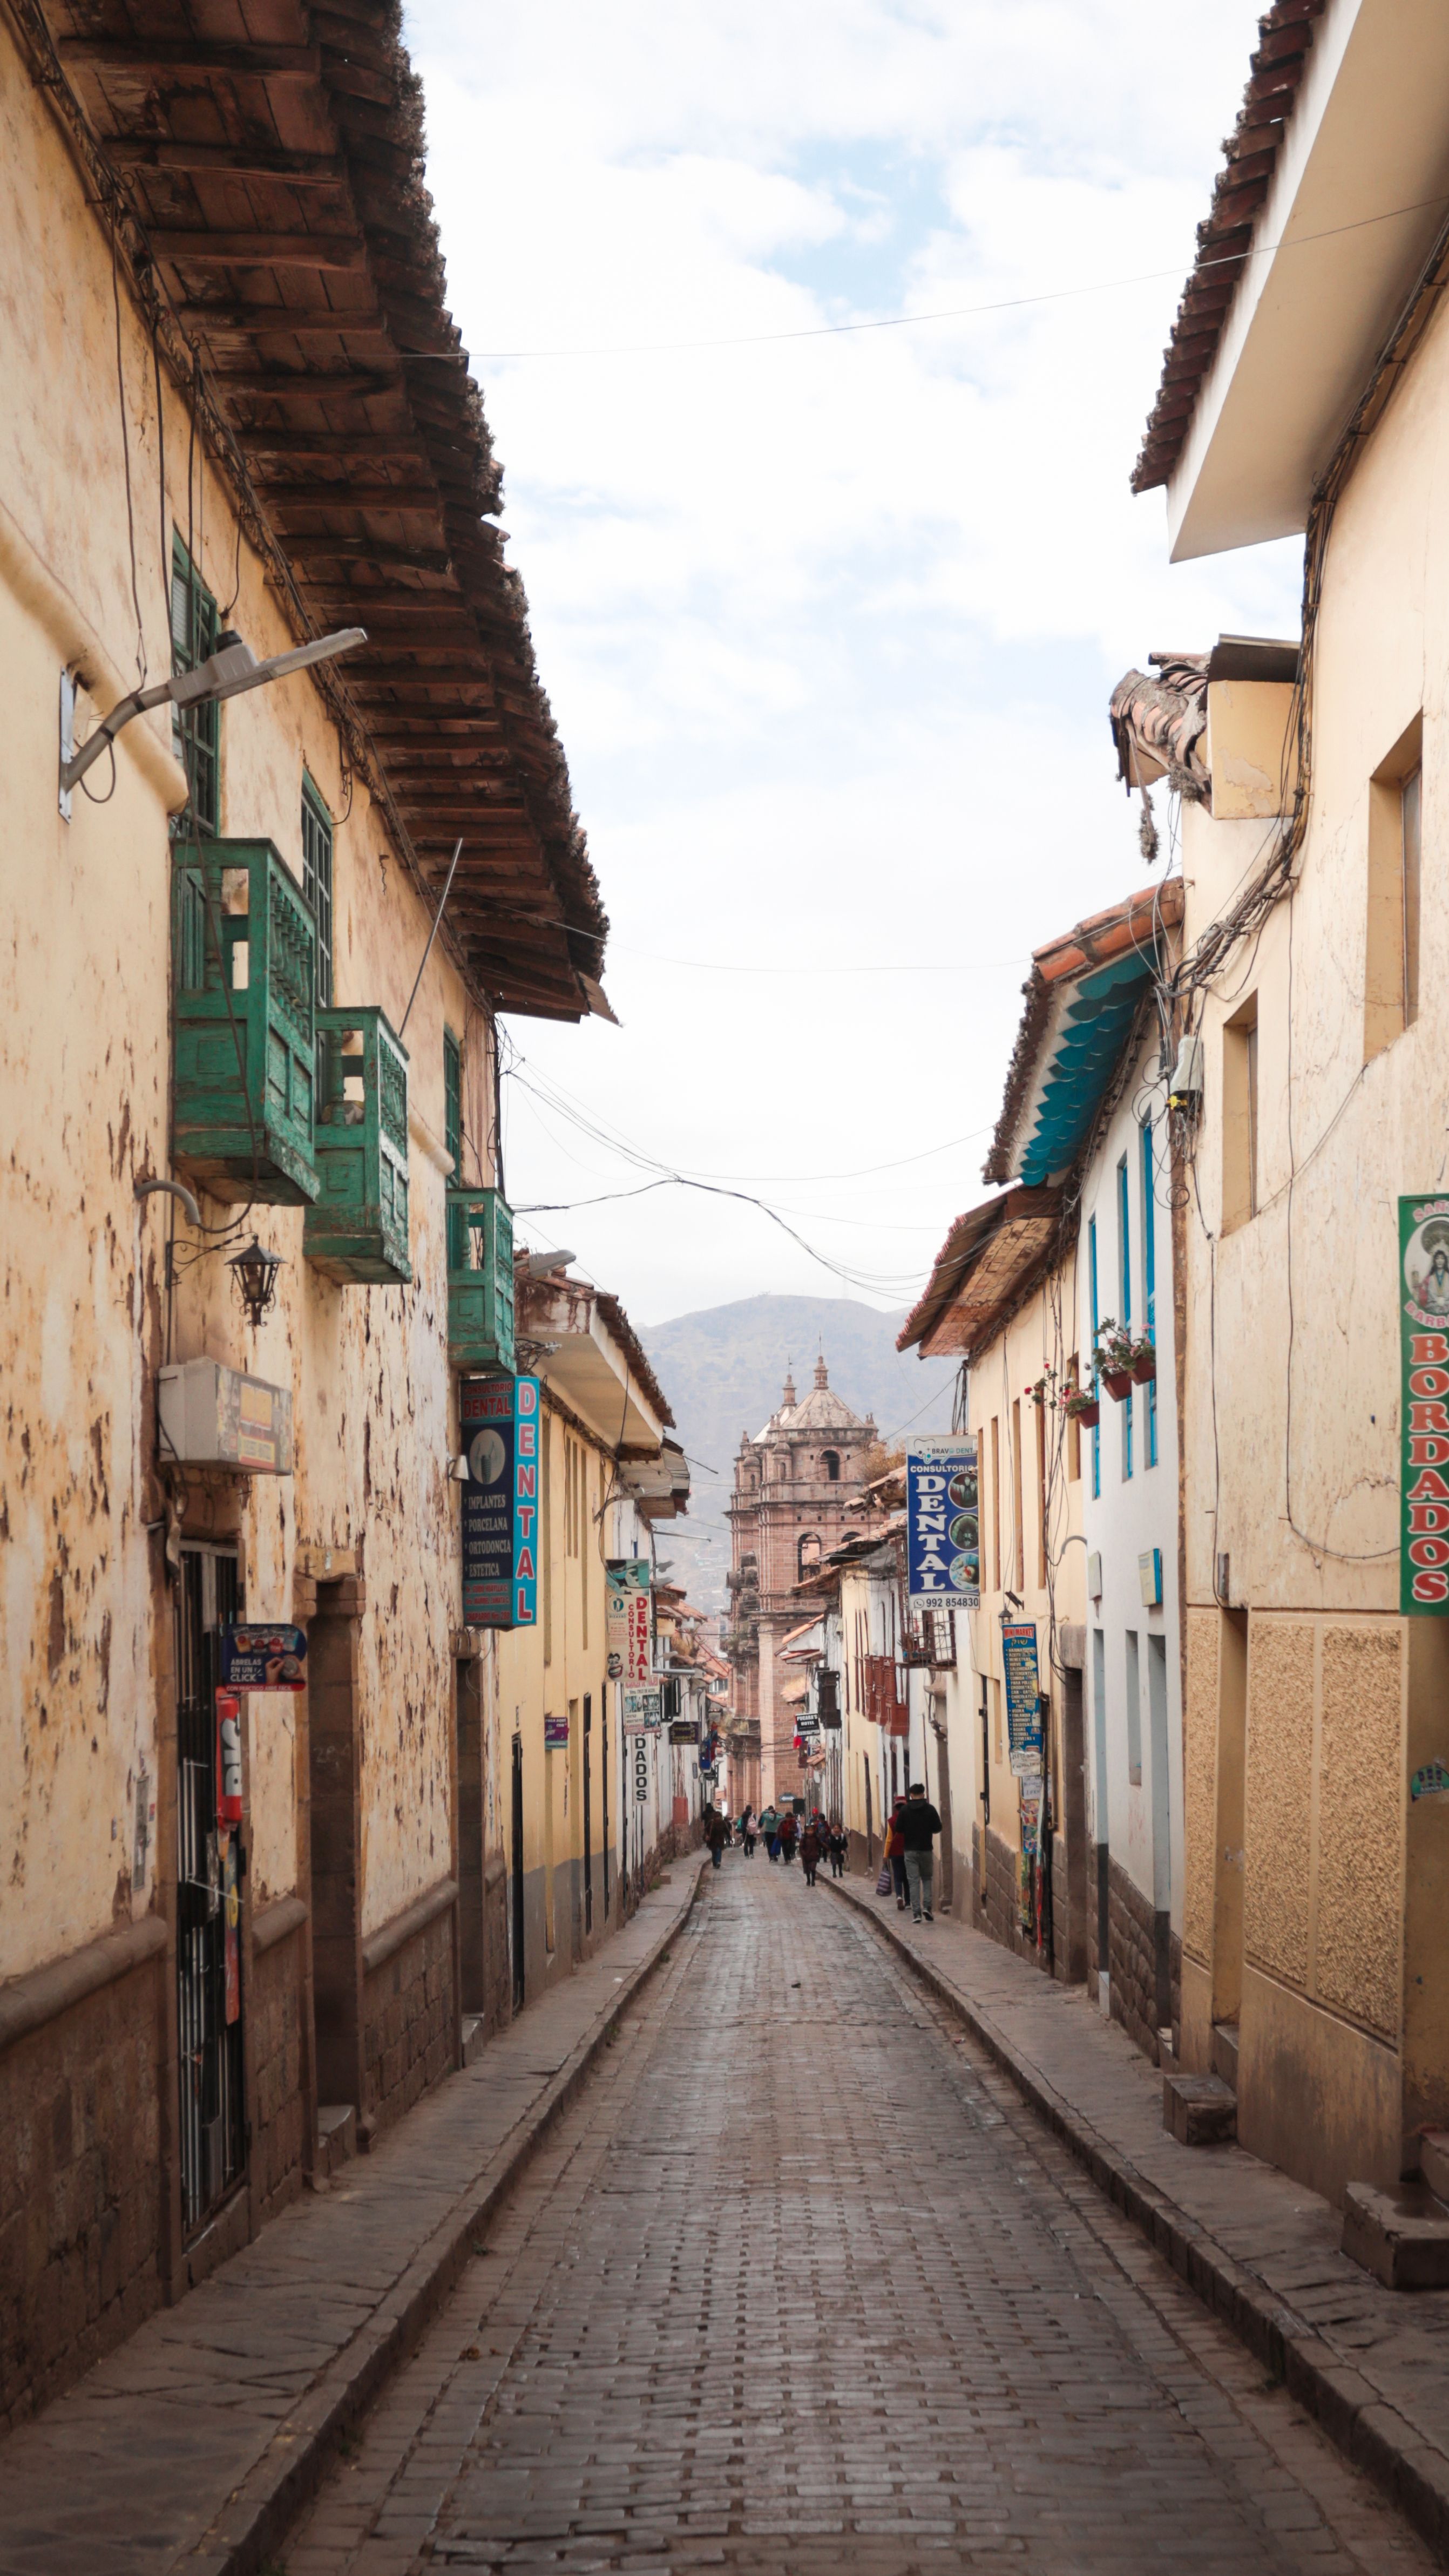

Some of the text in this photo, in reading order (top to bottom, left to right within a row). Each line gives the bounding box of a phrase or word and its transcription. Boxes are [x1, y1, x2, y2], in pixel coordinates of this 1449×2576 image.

[1413, 1200, 1449, 1222] SAN
[1405, 1300, 1449, 1328] BARB
[464, 1382, 512, 1395] CONSULTORIO
[464, 1397, 511, 1419] DENTAL
[1407, 1333, 1449, 1602] BORDADOS
[469, 1495, 505, 1509] IMPLANTES
[516, 1381, 536, 1622] DENTAL
[469, 1517, 507, 1532] PORCELANA
[916, 1476, 949, 1590] DENTAL
[469, 1540, 511, 1555] ORTODONCIA
[926, 1598, 978, 1607] 992 854830
[636, 1597, 648, 1680] DENTAL
[1015, 1627, 1034, 1638] MARKET
[635, 1733, 647, 1801] DADOS
